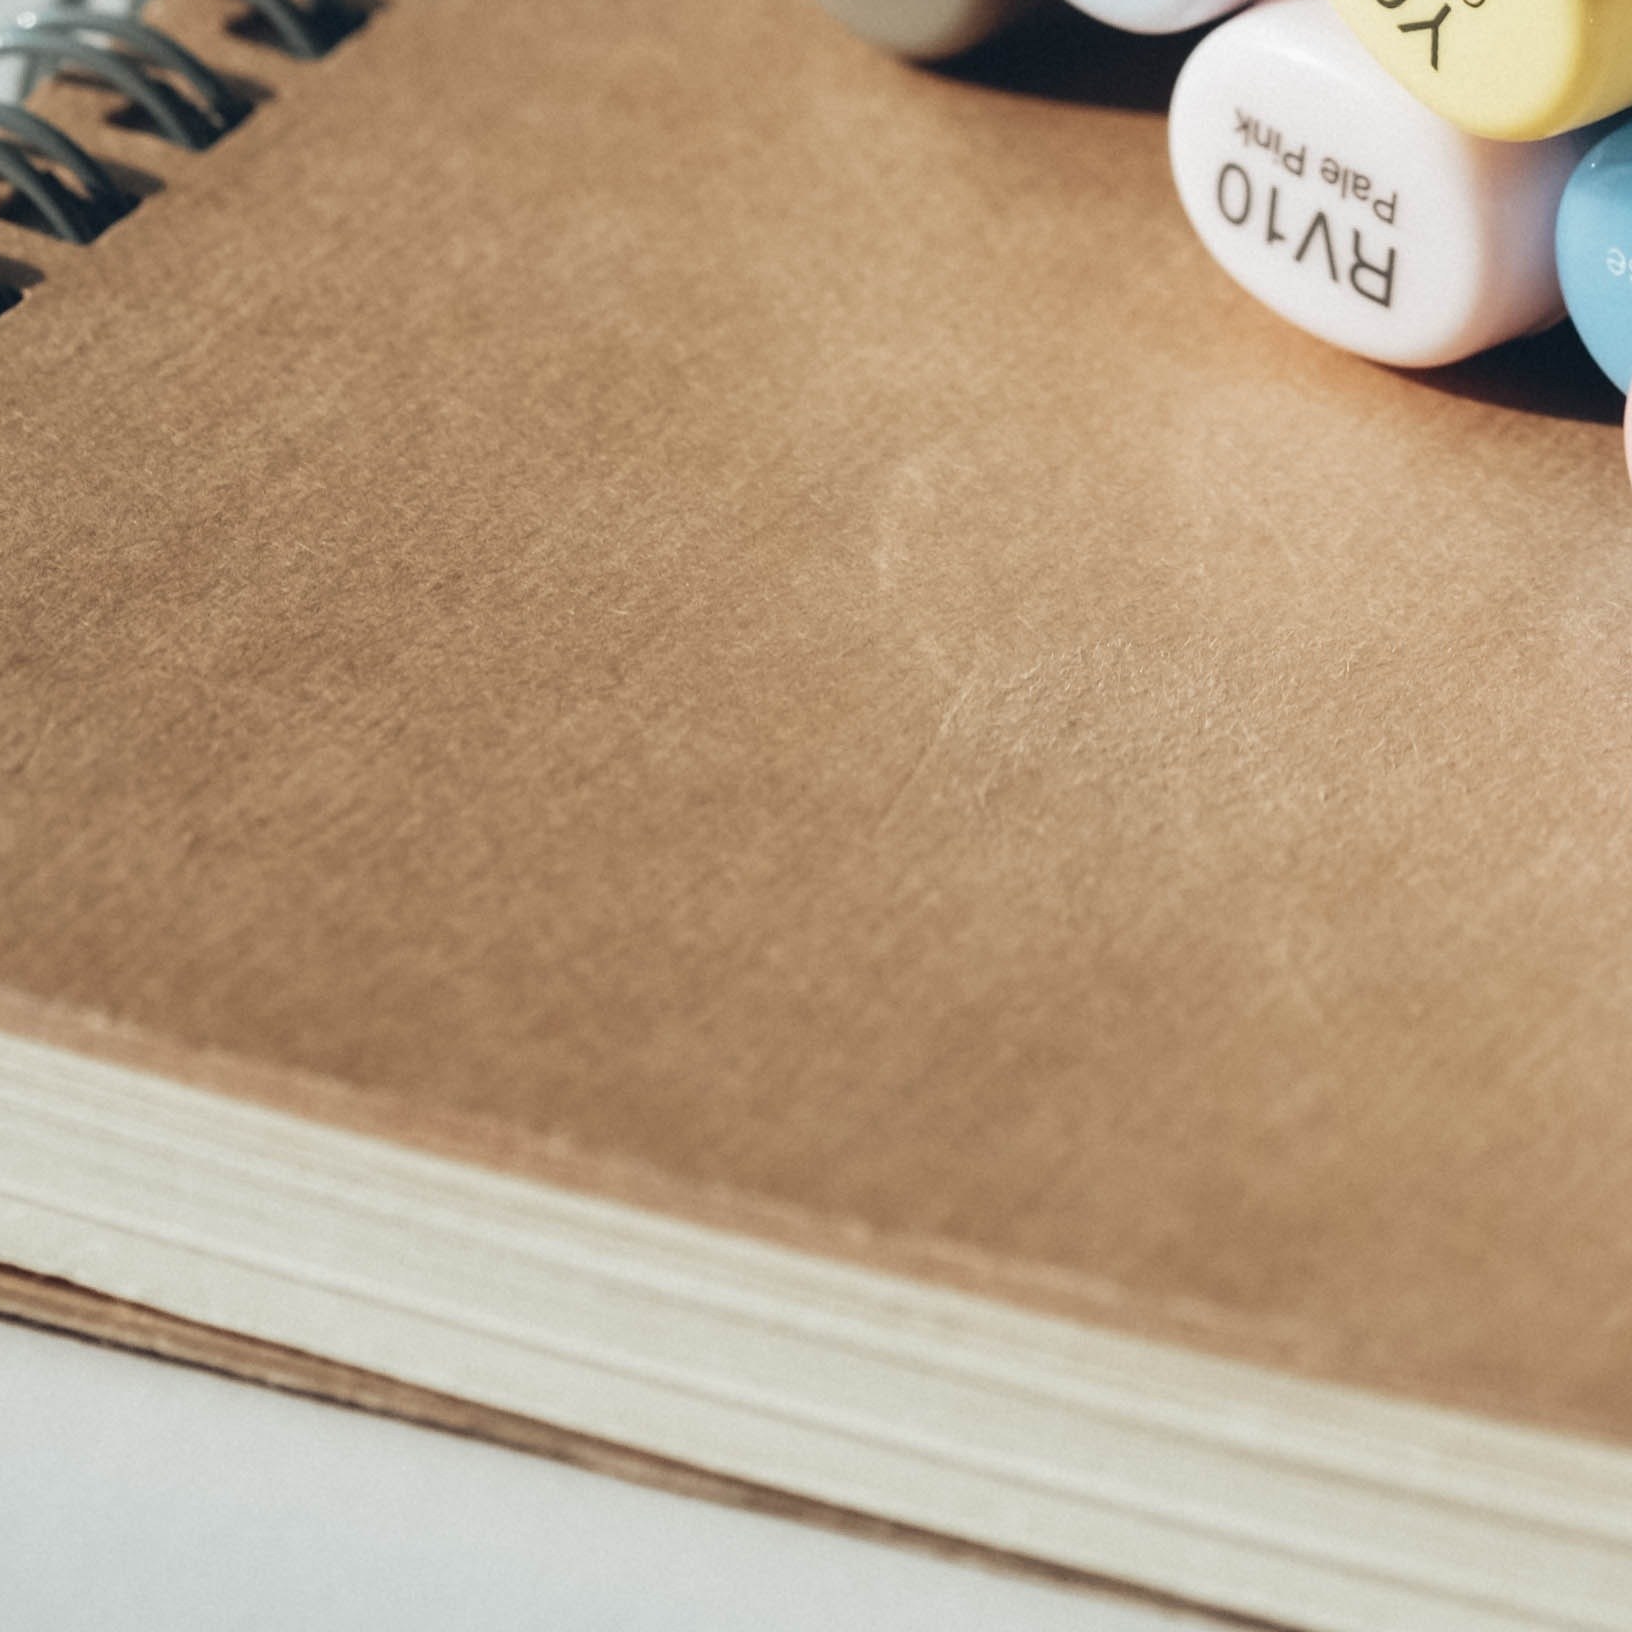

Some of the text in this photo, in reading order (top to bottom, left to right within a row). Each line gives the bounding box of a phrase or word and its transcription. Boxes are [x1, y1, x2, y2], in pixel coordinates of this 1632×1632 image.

[1233, 108, 1397, 224] Pale Pink
[1217, 162, 1395, 309] RV10
